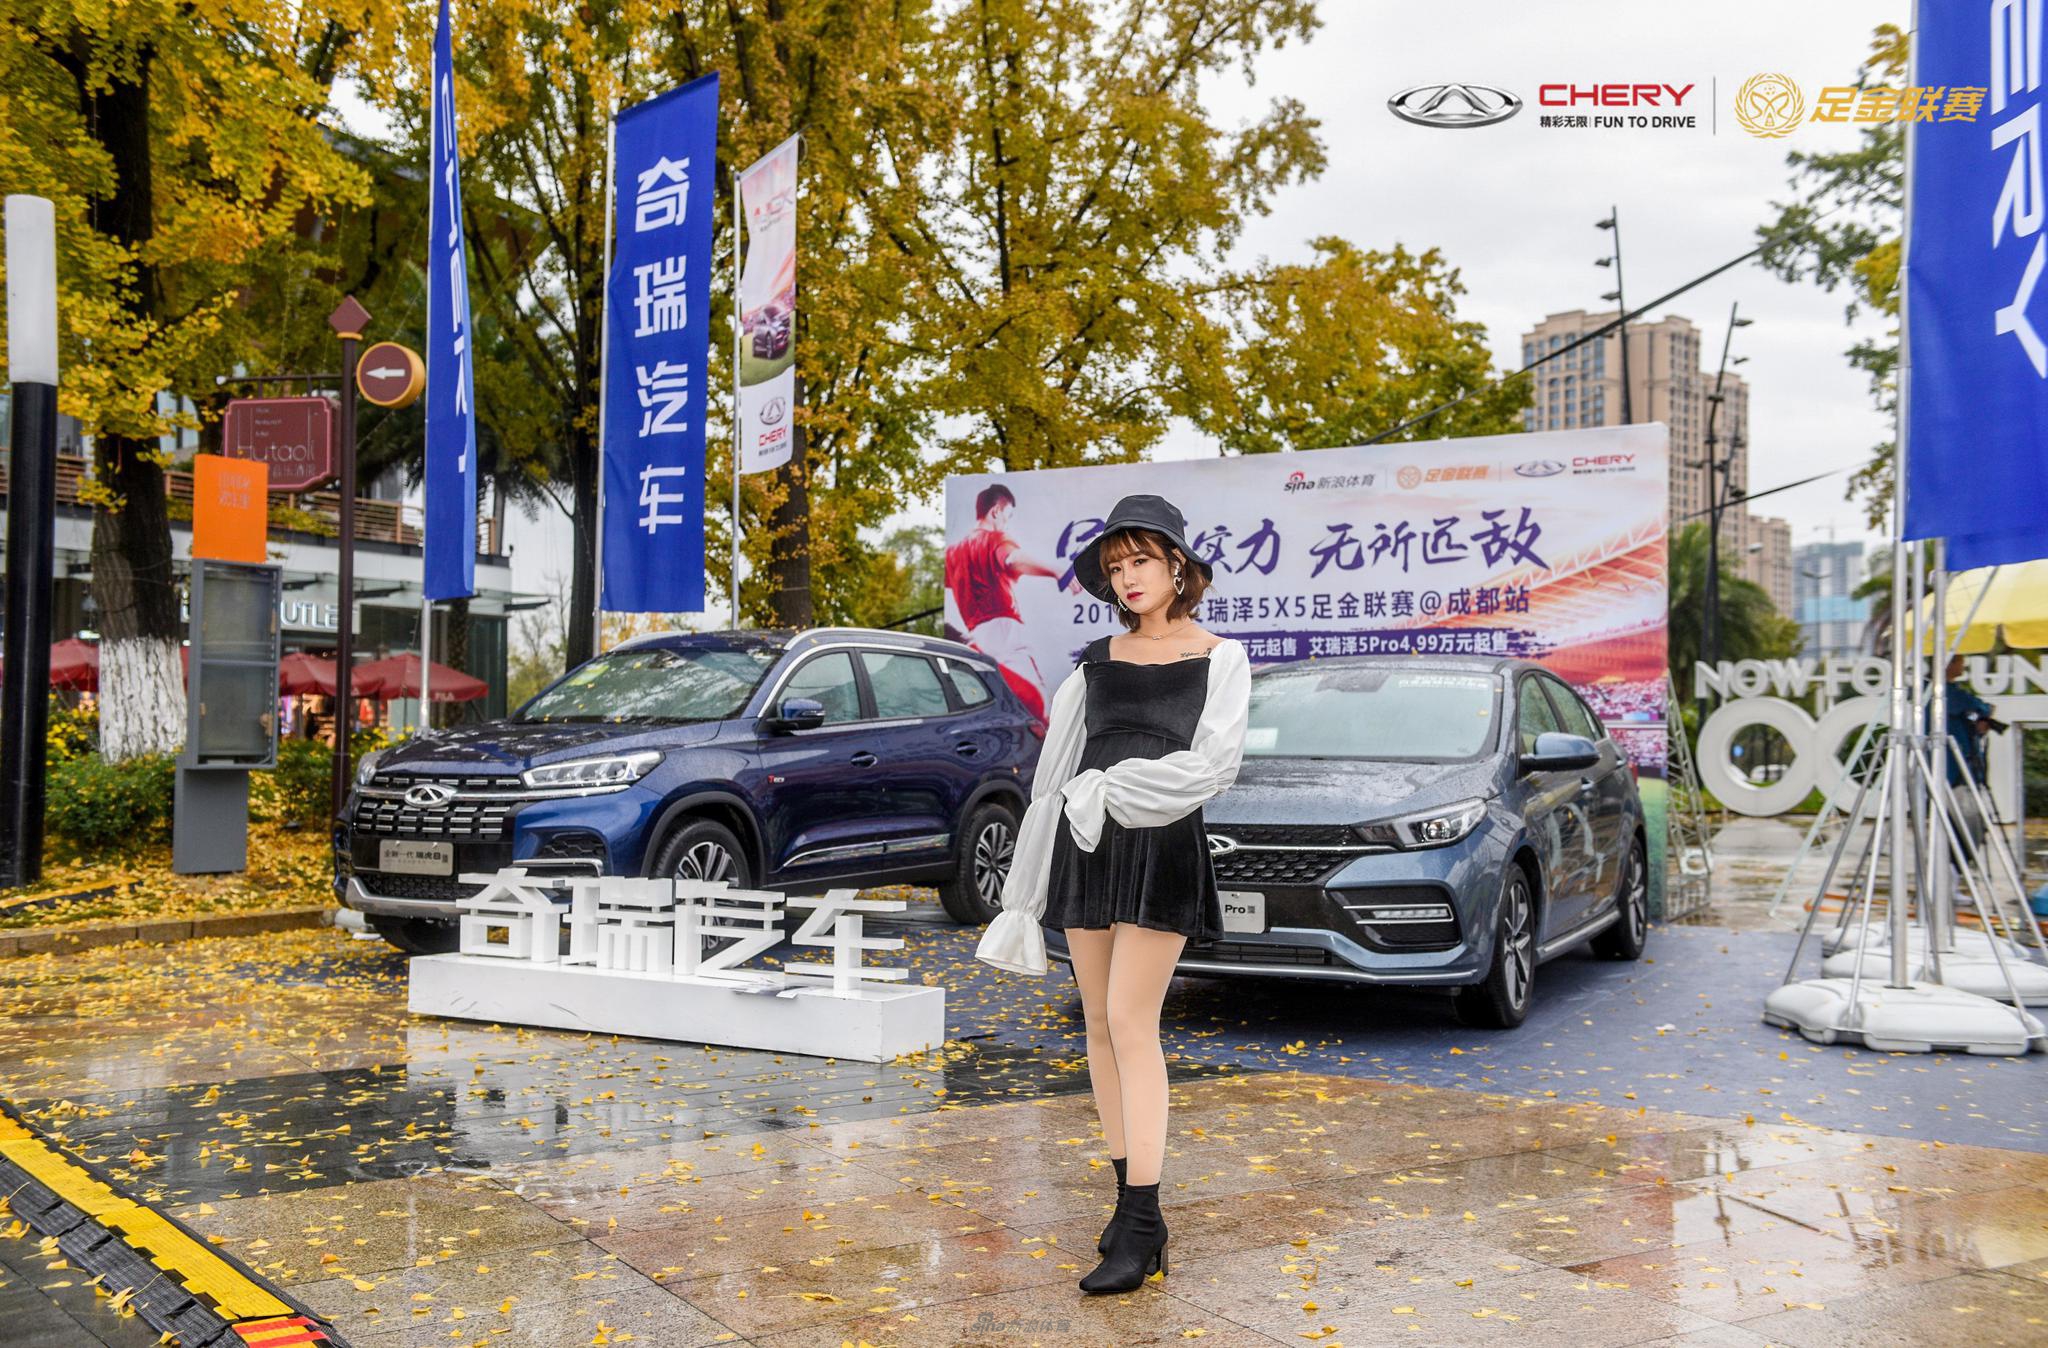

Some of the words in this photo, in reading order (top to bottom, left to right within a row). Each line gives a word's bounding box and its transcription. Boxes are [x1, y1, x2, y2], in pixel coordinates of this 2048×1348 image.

[634, 156, 690, 535] 奇瑞汽车
[759, 424, 787, 447] CHERY
[1572, 453, 1636, 467] CHERY
[1284, 473, 1315, 494] sina
[1317, 474, 1375, 490] 新浪体育
[1424, 465, 1490, 483] 足金联赛
[1694, 657, 1818, 698] NOW
[1964, 654, 2048, 695] UN
[1225, 904, 1246, 914] Pro
[456, 868, 909, 998] 奇瑞汽车
